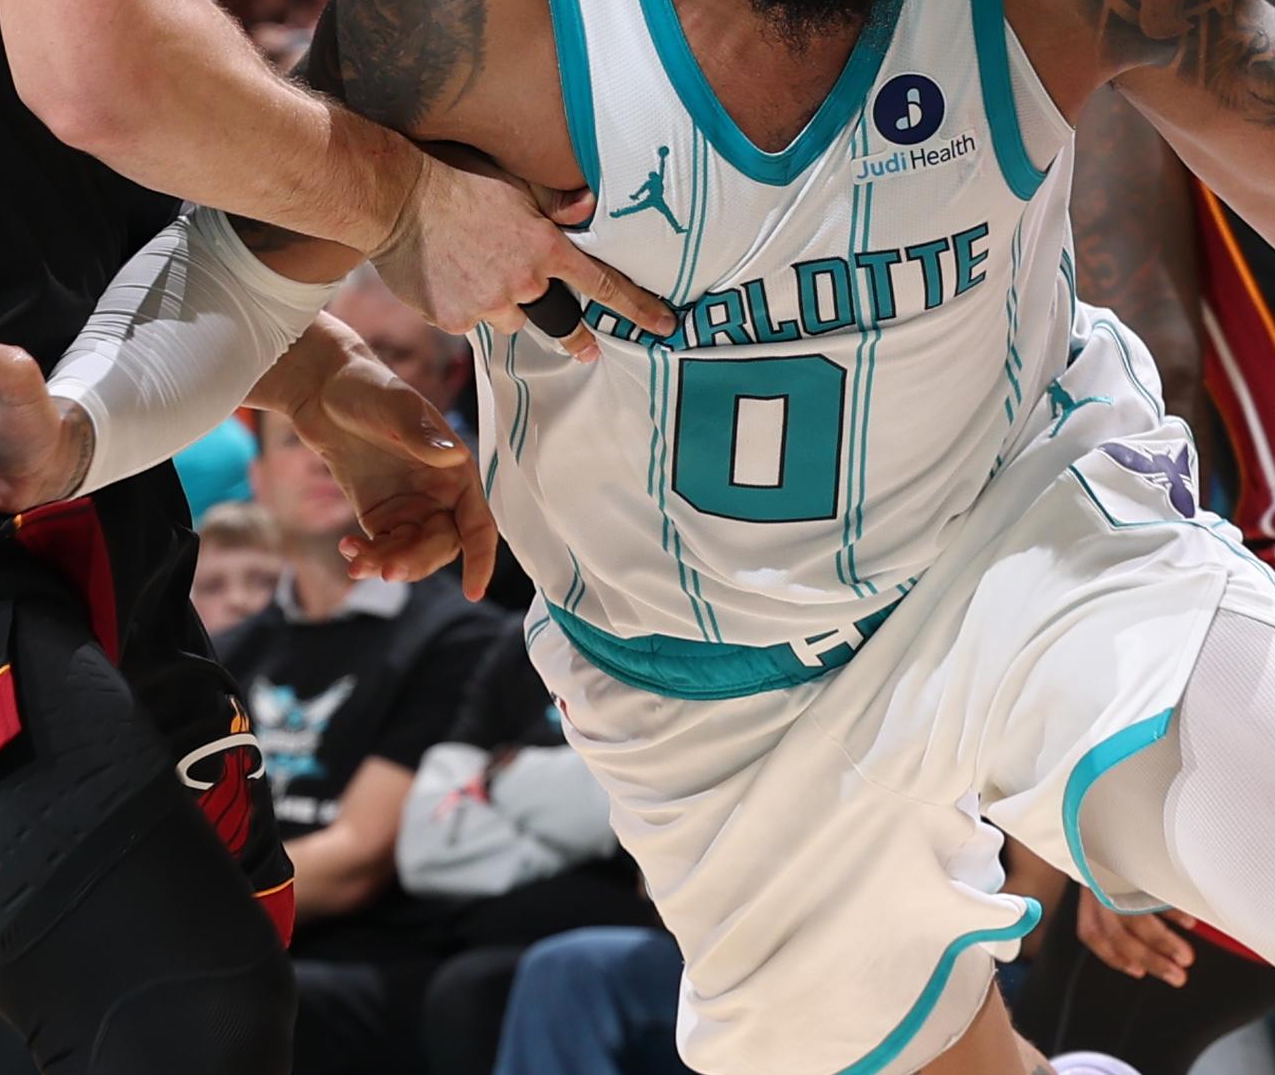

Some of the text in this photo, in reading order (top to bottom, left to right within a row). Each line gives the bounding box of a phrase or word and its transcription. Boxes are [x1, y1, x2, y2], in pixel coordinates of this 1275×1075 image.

[856, 133, 976, 180] Judi Health
[583, 221, 989, 353] RLOTTE
[671, 353, 848, 524] 0
